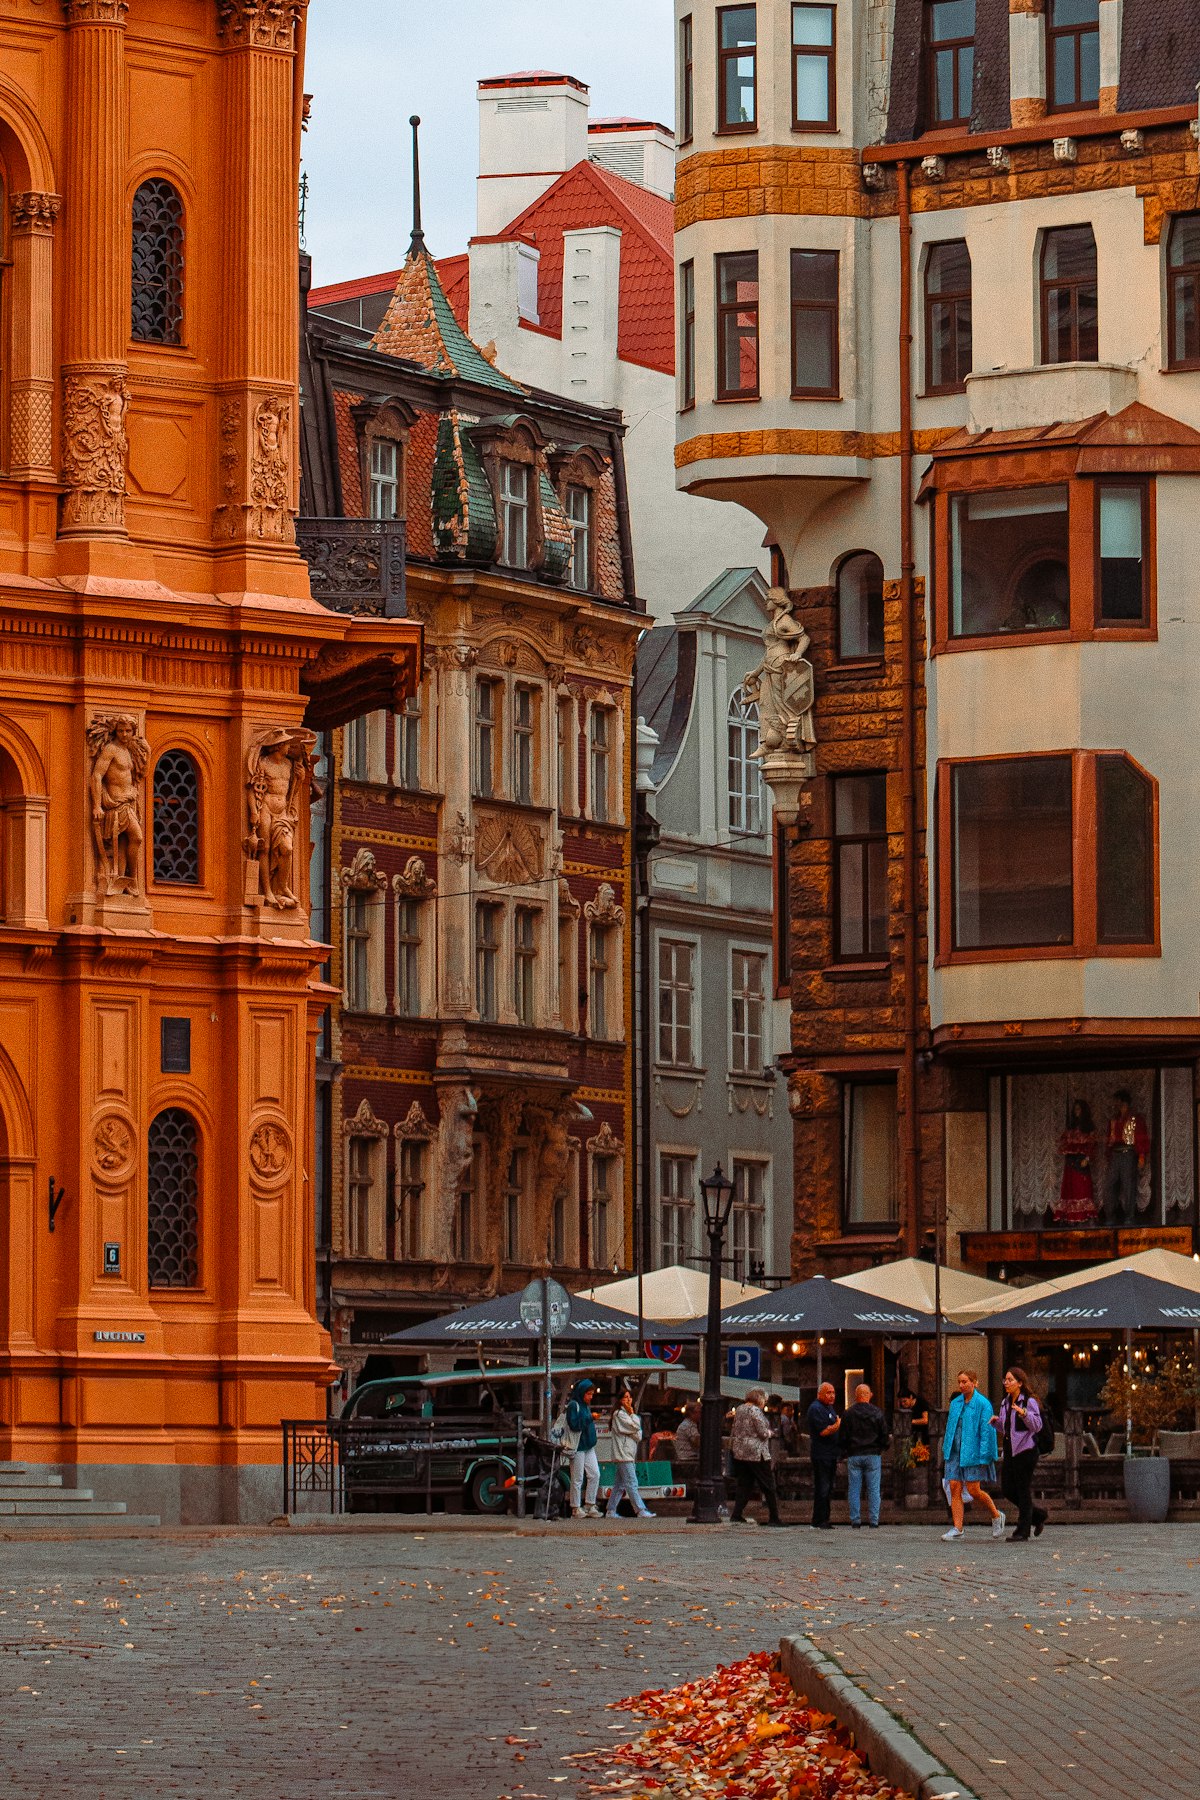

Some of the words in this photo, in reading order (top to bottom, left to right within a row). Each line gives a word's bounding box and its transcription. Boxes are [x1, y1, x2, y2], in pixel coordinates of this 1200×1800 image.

[109, 1249, 116, 1262] 6
[852, 1311, 919, 1323] MEŽPILS
[1026, 1306, 1109, 1318] MEŽPILS
[1158, 1306, 1200, 1317] MEŽP
[720, 1312, 805, 1324] MEŽPILS
[444, 1319, 522, 1330] MEŽPILS
[569, 1319, 640, 1330] MEŽPILS
[735, 1350, 752, 1376] P
